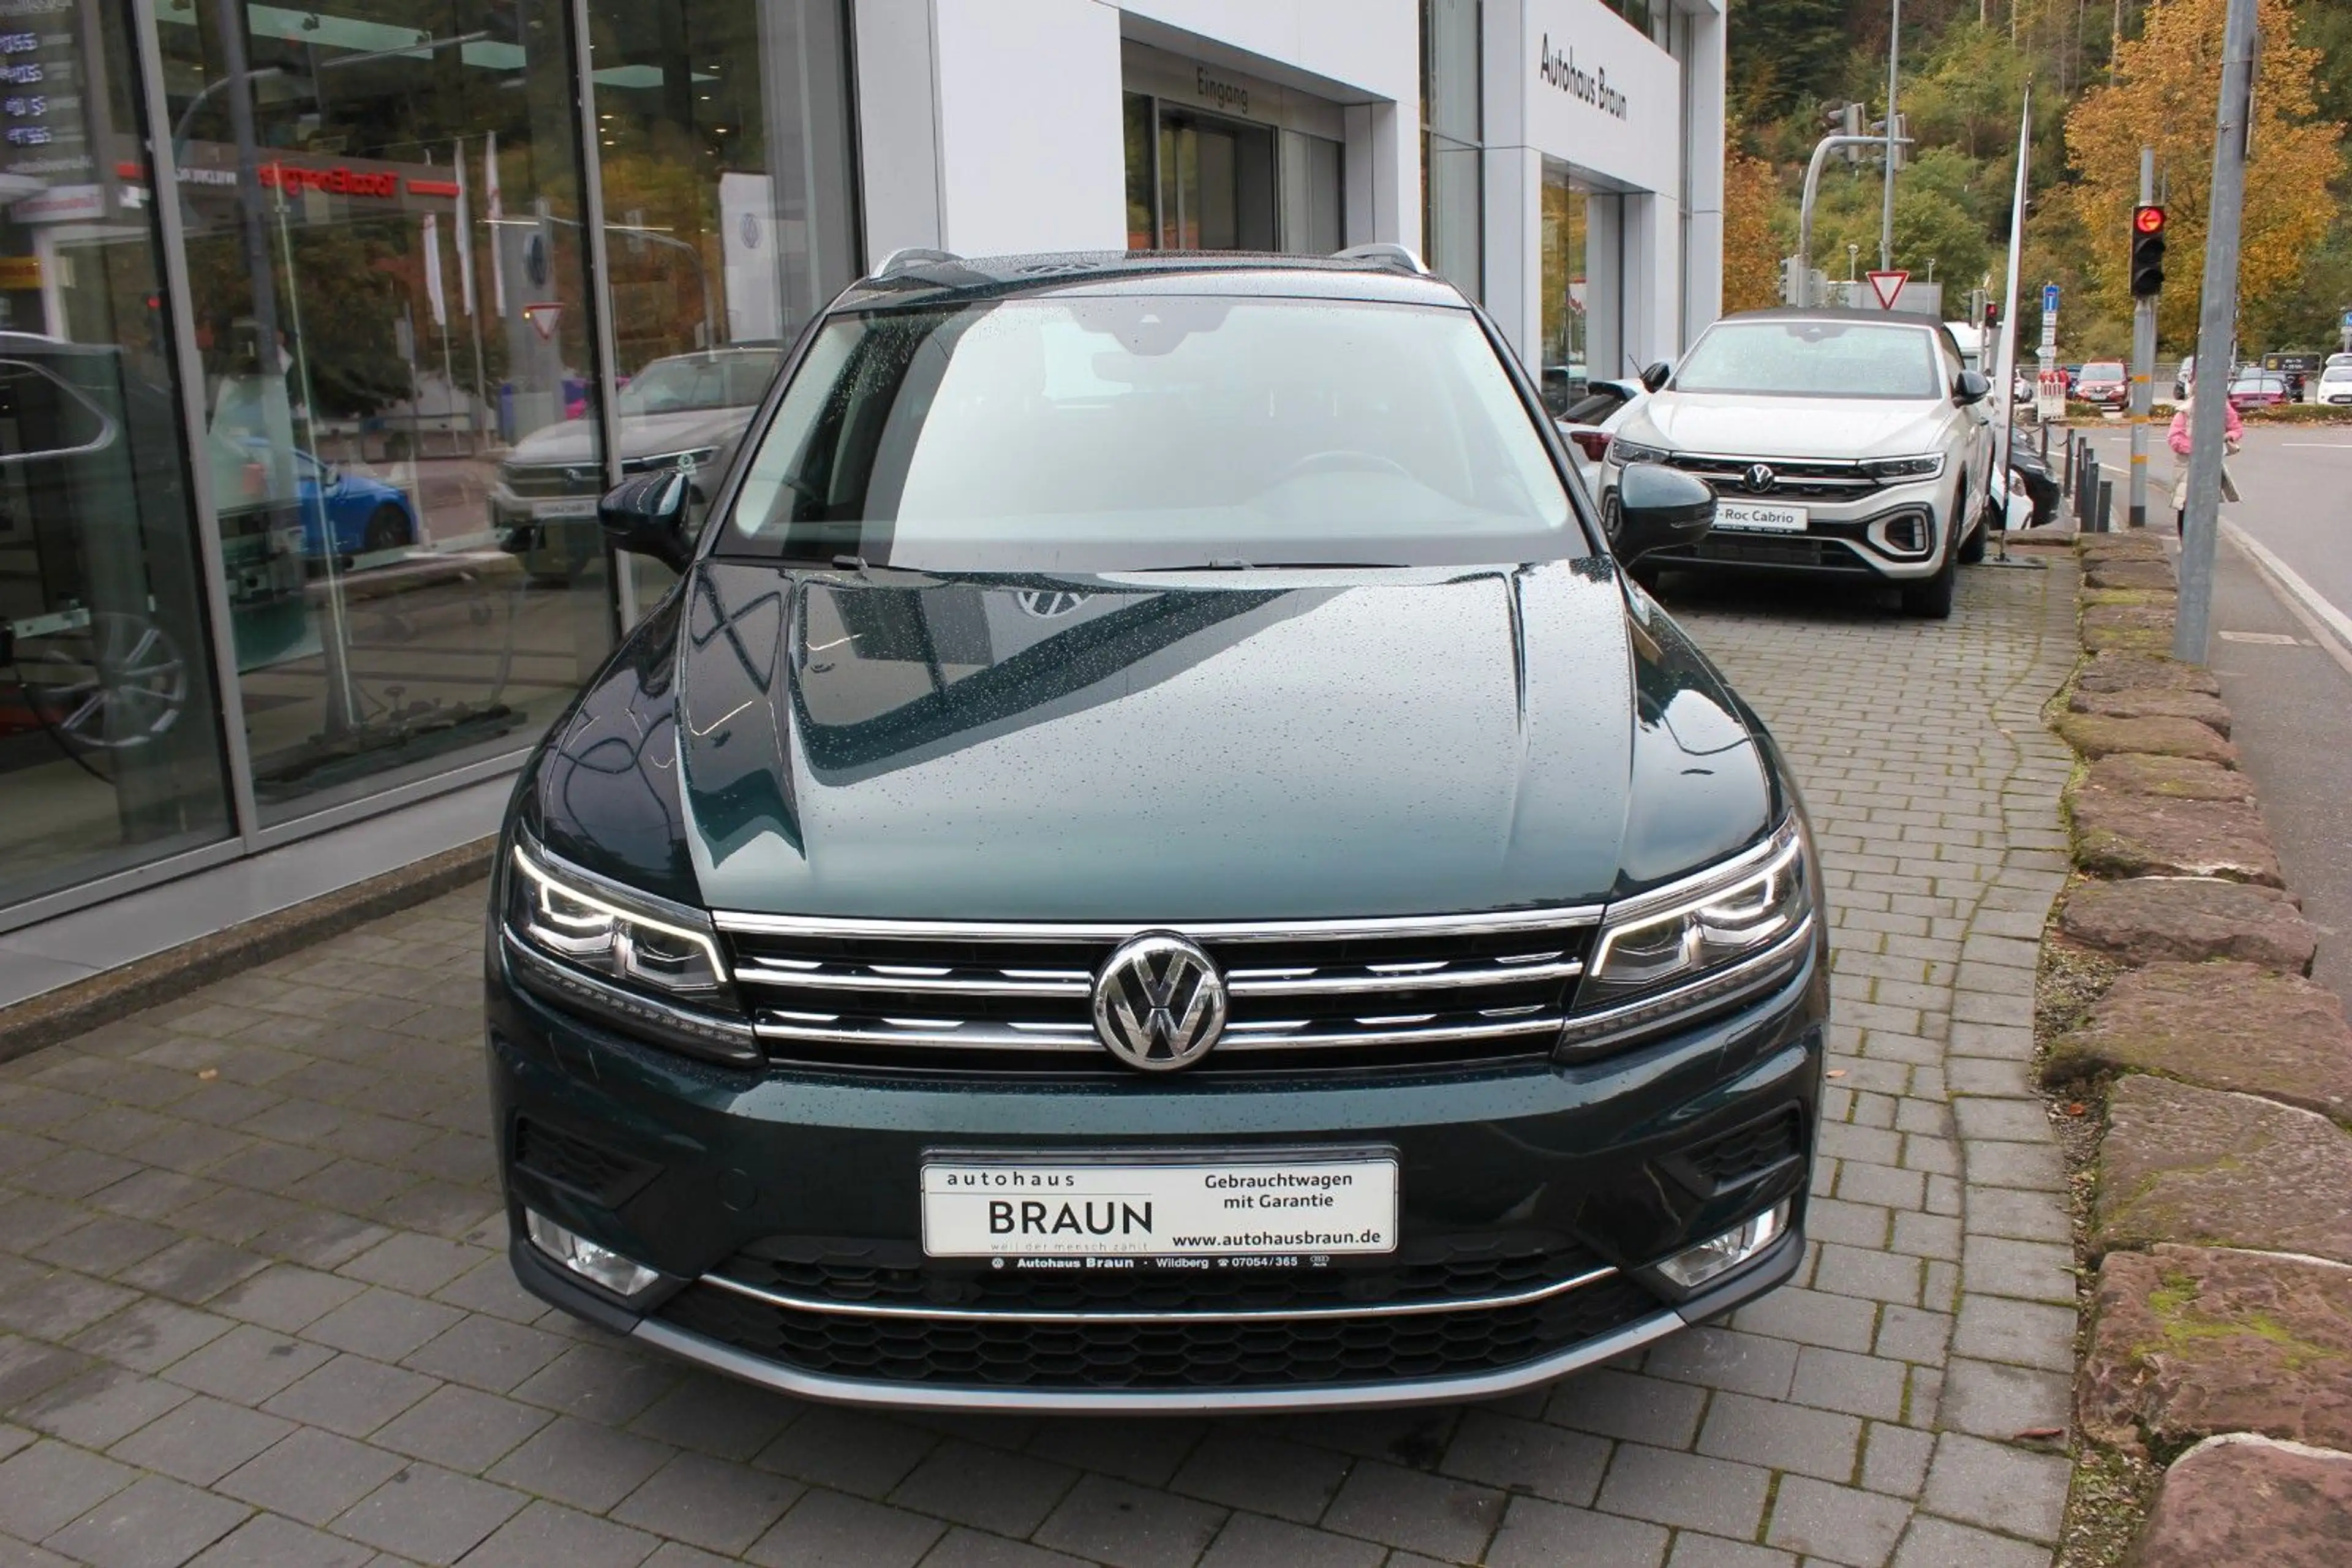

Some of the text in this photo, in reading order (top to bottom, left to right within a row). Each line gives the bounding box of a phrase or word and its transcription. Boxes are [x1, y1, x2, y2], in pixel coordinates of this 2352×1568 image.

[1540, 32, 1627, 122] Autohaus Braun
[1197, 66, 1248, 115] Eingang
[1752, 510, 1795, 524] Cabrio
[947, 1171, 1075, 1186] autohaus
[1204, 1172, 1353, 1189] Gebrauchtwagen
[1224, 1193, 1335, 1209] mit Garantie
[989, 1200, 1152, 1235] BRAUN
[1172, 1229, 1381, 1247] www.autohausbraun.de
[1017, 1257, 1081, 1268] Autohaus
[1086, 1257, 1134, 1268] Braun
[1156, 1257, 1210, 1269] Wildberg
